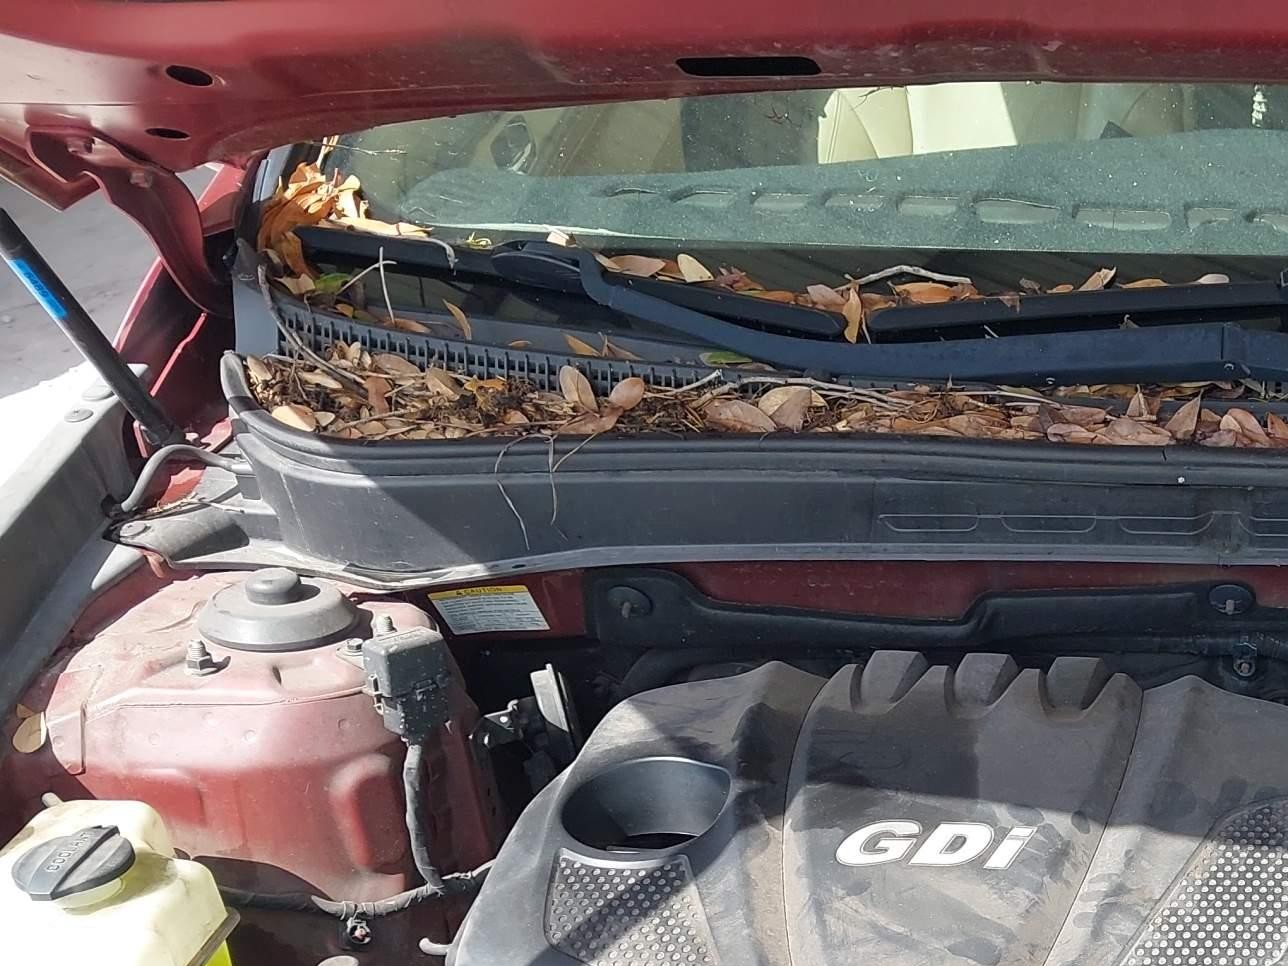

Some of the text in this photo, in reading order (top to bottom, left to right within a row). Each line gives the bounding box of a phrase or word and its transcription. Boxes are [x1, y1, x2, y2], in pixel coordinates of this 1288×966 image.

[464, 587, 503, 595] CAUTION
[45, 832, 89, 872] COOLANT
[835, 818, 1038, 870] GDi
